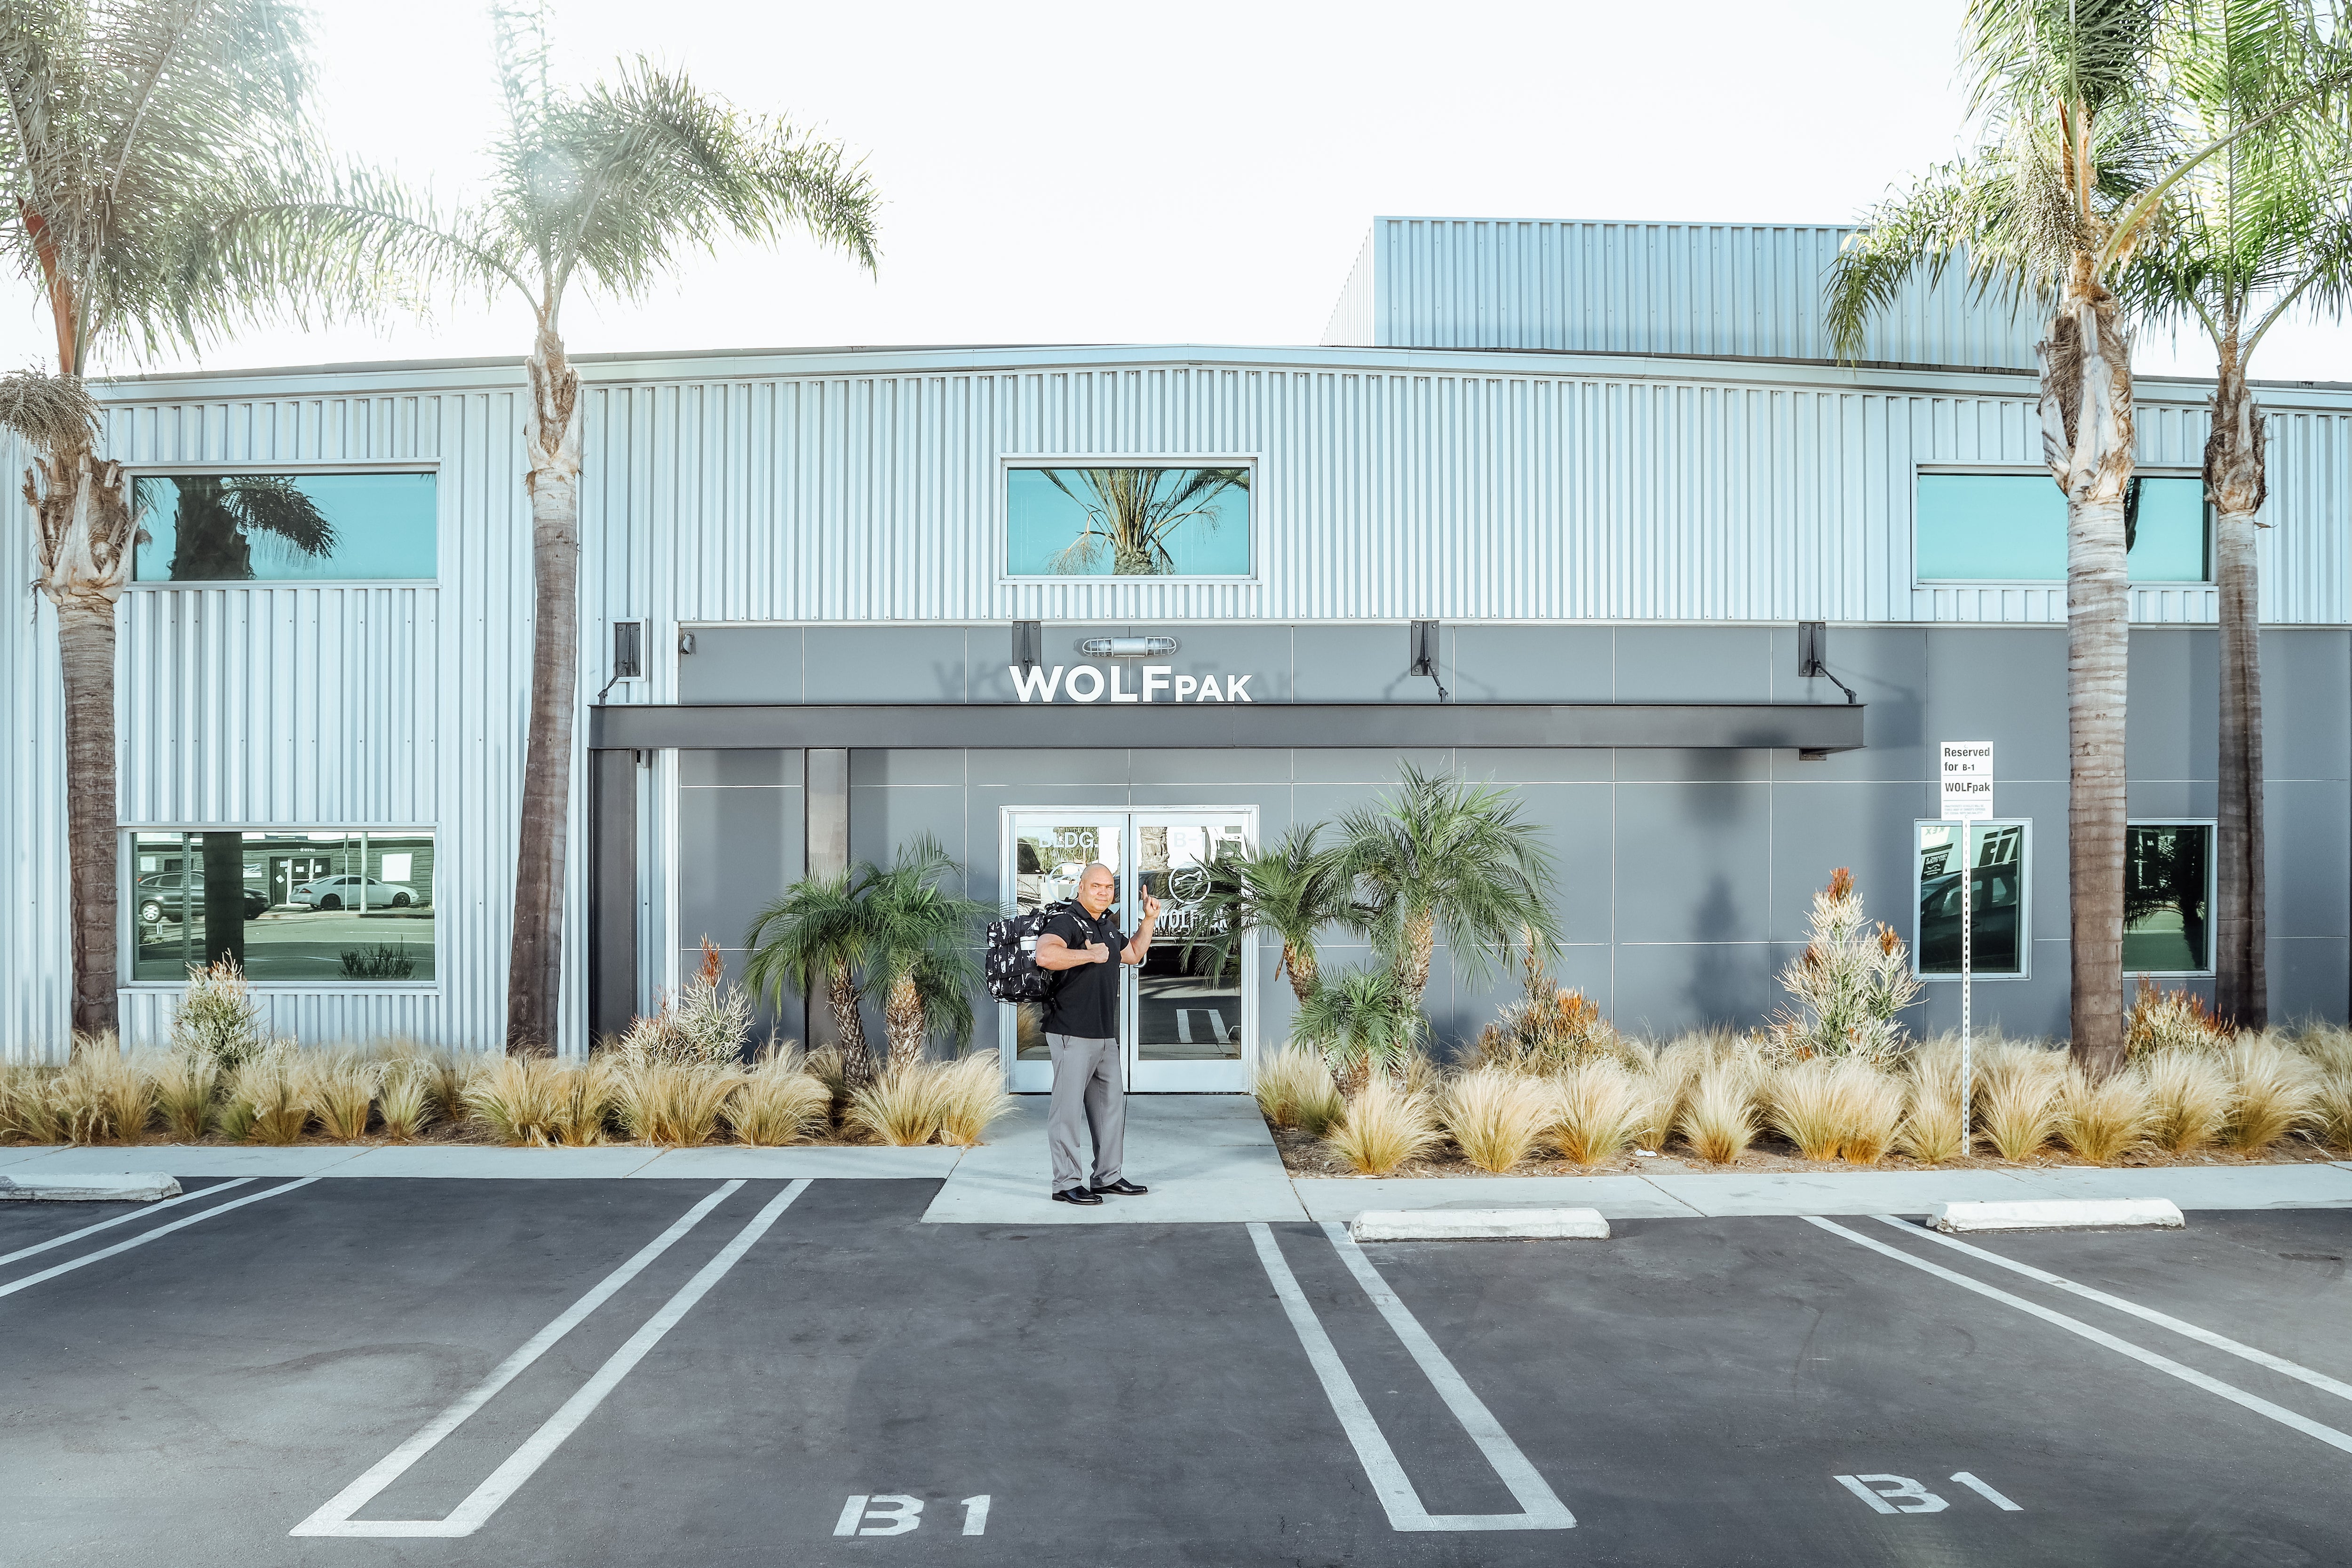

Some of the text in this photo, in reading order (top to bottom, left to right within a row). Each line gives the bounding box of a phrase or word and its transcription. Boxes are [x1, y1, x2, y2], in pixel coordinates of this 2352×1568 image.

[1008, 665, 1253, 702] WOLFPAK
[1944, 747, 1990, 756] Reserved
[1944, 762, 1958, 771] for
[1945, 782, 1990, 793] WOLFpak
[1039, 832, 1205, 848] BLDG. B-1
